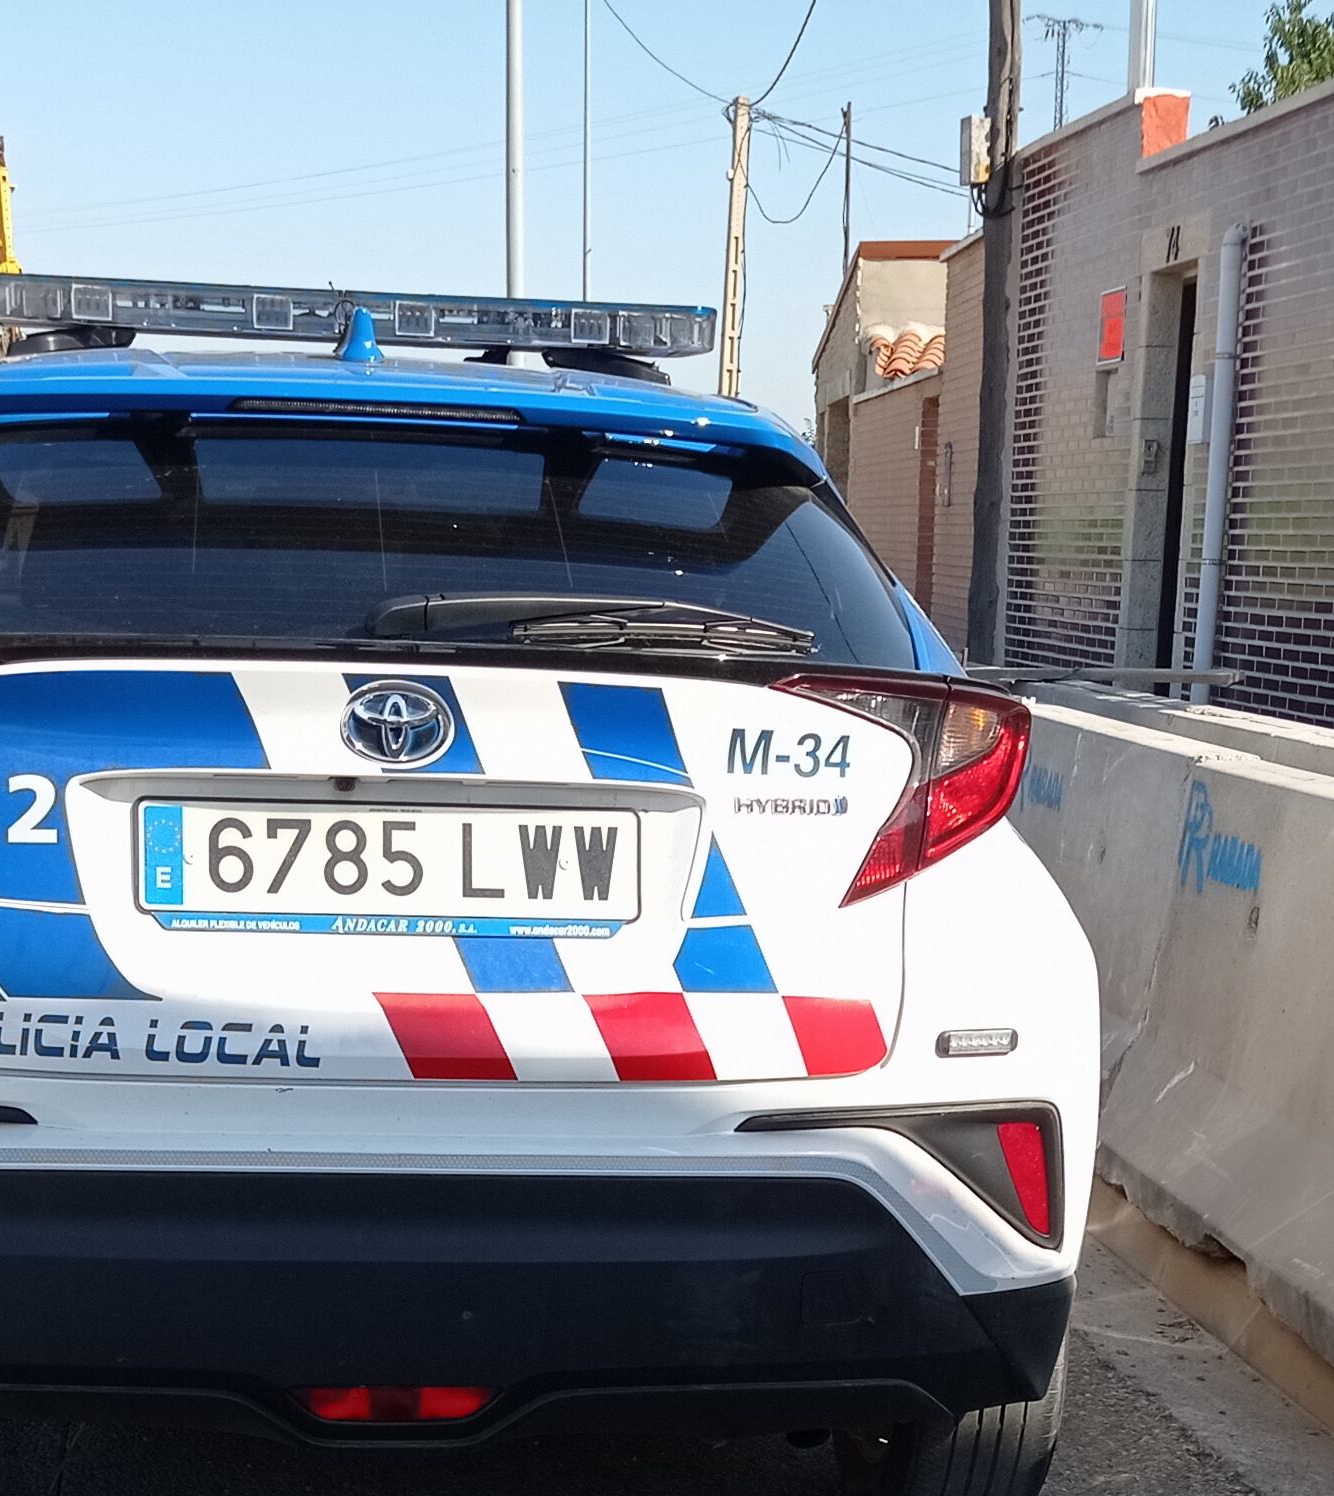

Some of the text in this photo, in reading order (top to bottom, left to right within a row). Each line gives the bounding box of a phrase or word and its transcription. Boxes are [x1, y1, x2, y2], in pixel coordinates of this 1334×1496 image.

[727, 728, 850, 778] M-34
[734, 797, 831, 816] HYBRID
[208, 817, 618, 901] 6785 LWW
[156, 867, 172, 888] E
[331, 915, 408, 934] ANDACAR
[509, 923, 612, 937] www.andacar2000.com
[145, 1019, 321, 1068] LOCAL
